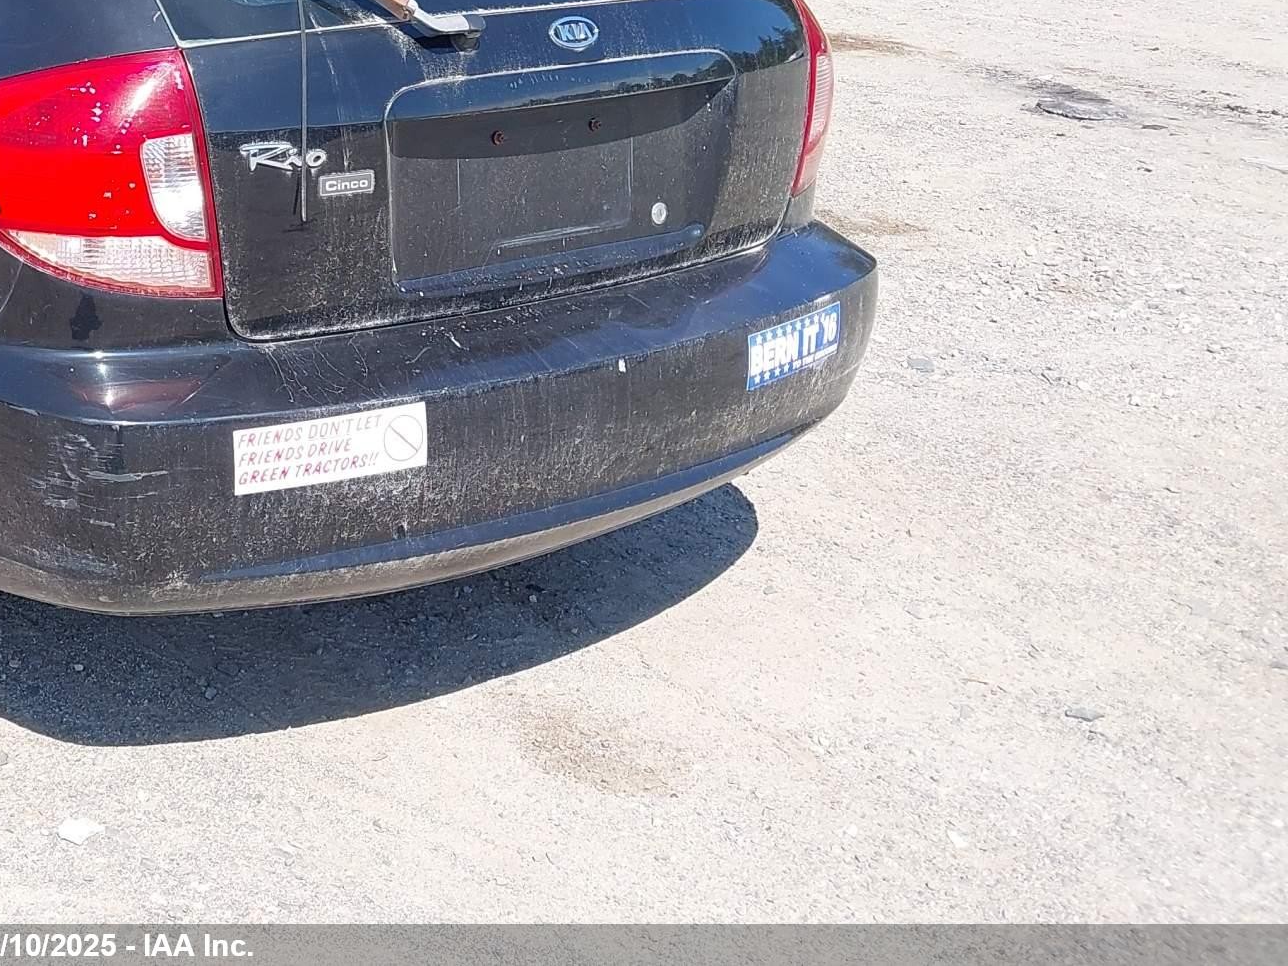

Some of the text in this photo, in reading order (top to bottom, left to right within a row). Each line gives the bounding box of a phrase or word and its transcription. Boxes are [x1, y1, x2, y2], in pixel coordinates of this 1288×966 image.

[556, 22, 593, 41] KIA
[240, 141, 327, 172] Rio
[325, 179, 369, 192] Cinco
[750, 331, 800, 377] BERN
[802, 324, 819, 356] IT
[238, 414, 383, 449] FRIENDS DON'T LET
[238, 437, 352, 467] FRIENDS DRIVE
[239, 451, 380, 485] GREEN TRACTORS!!
